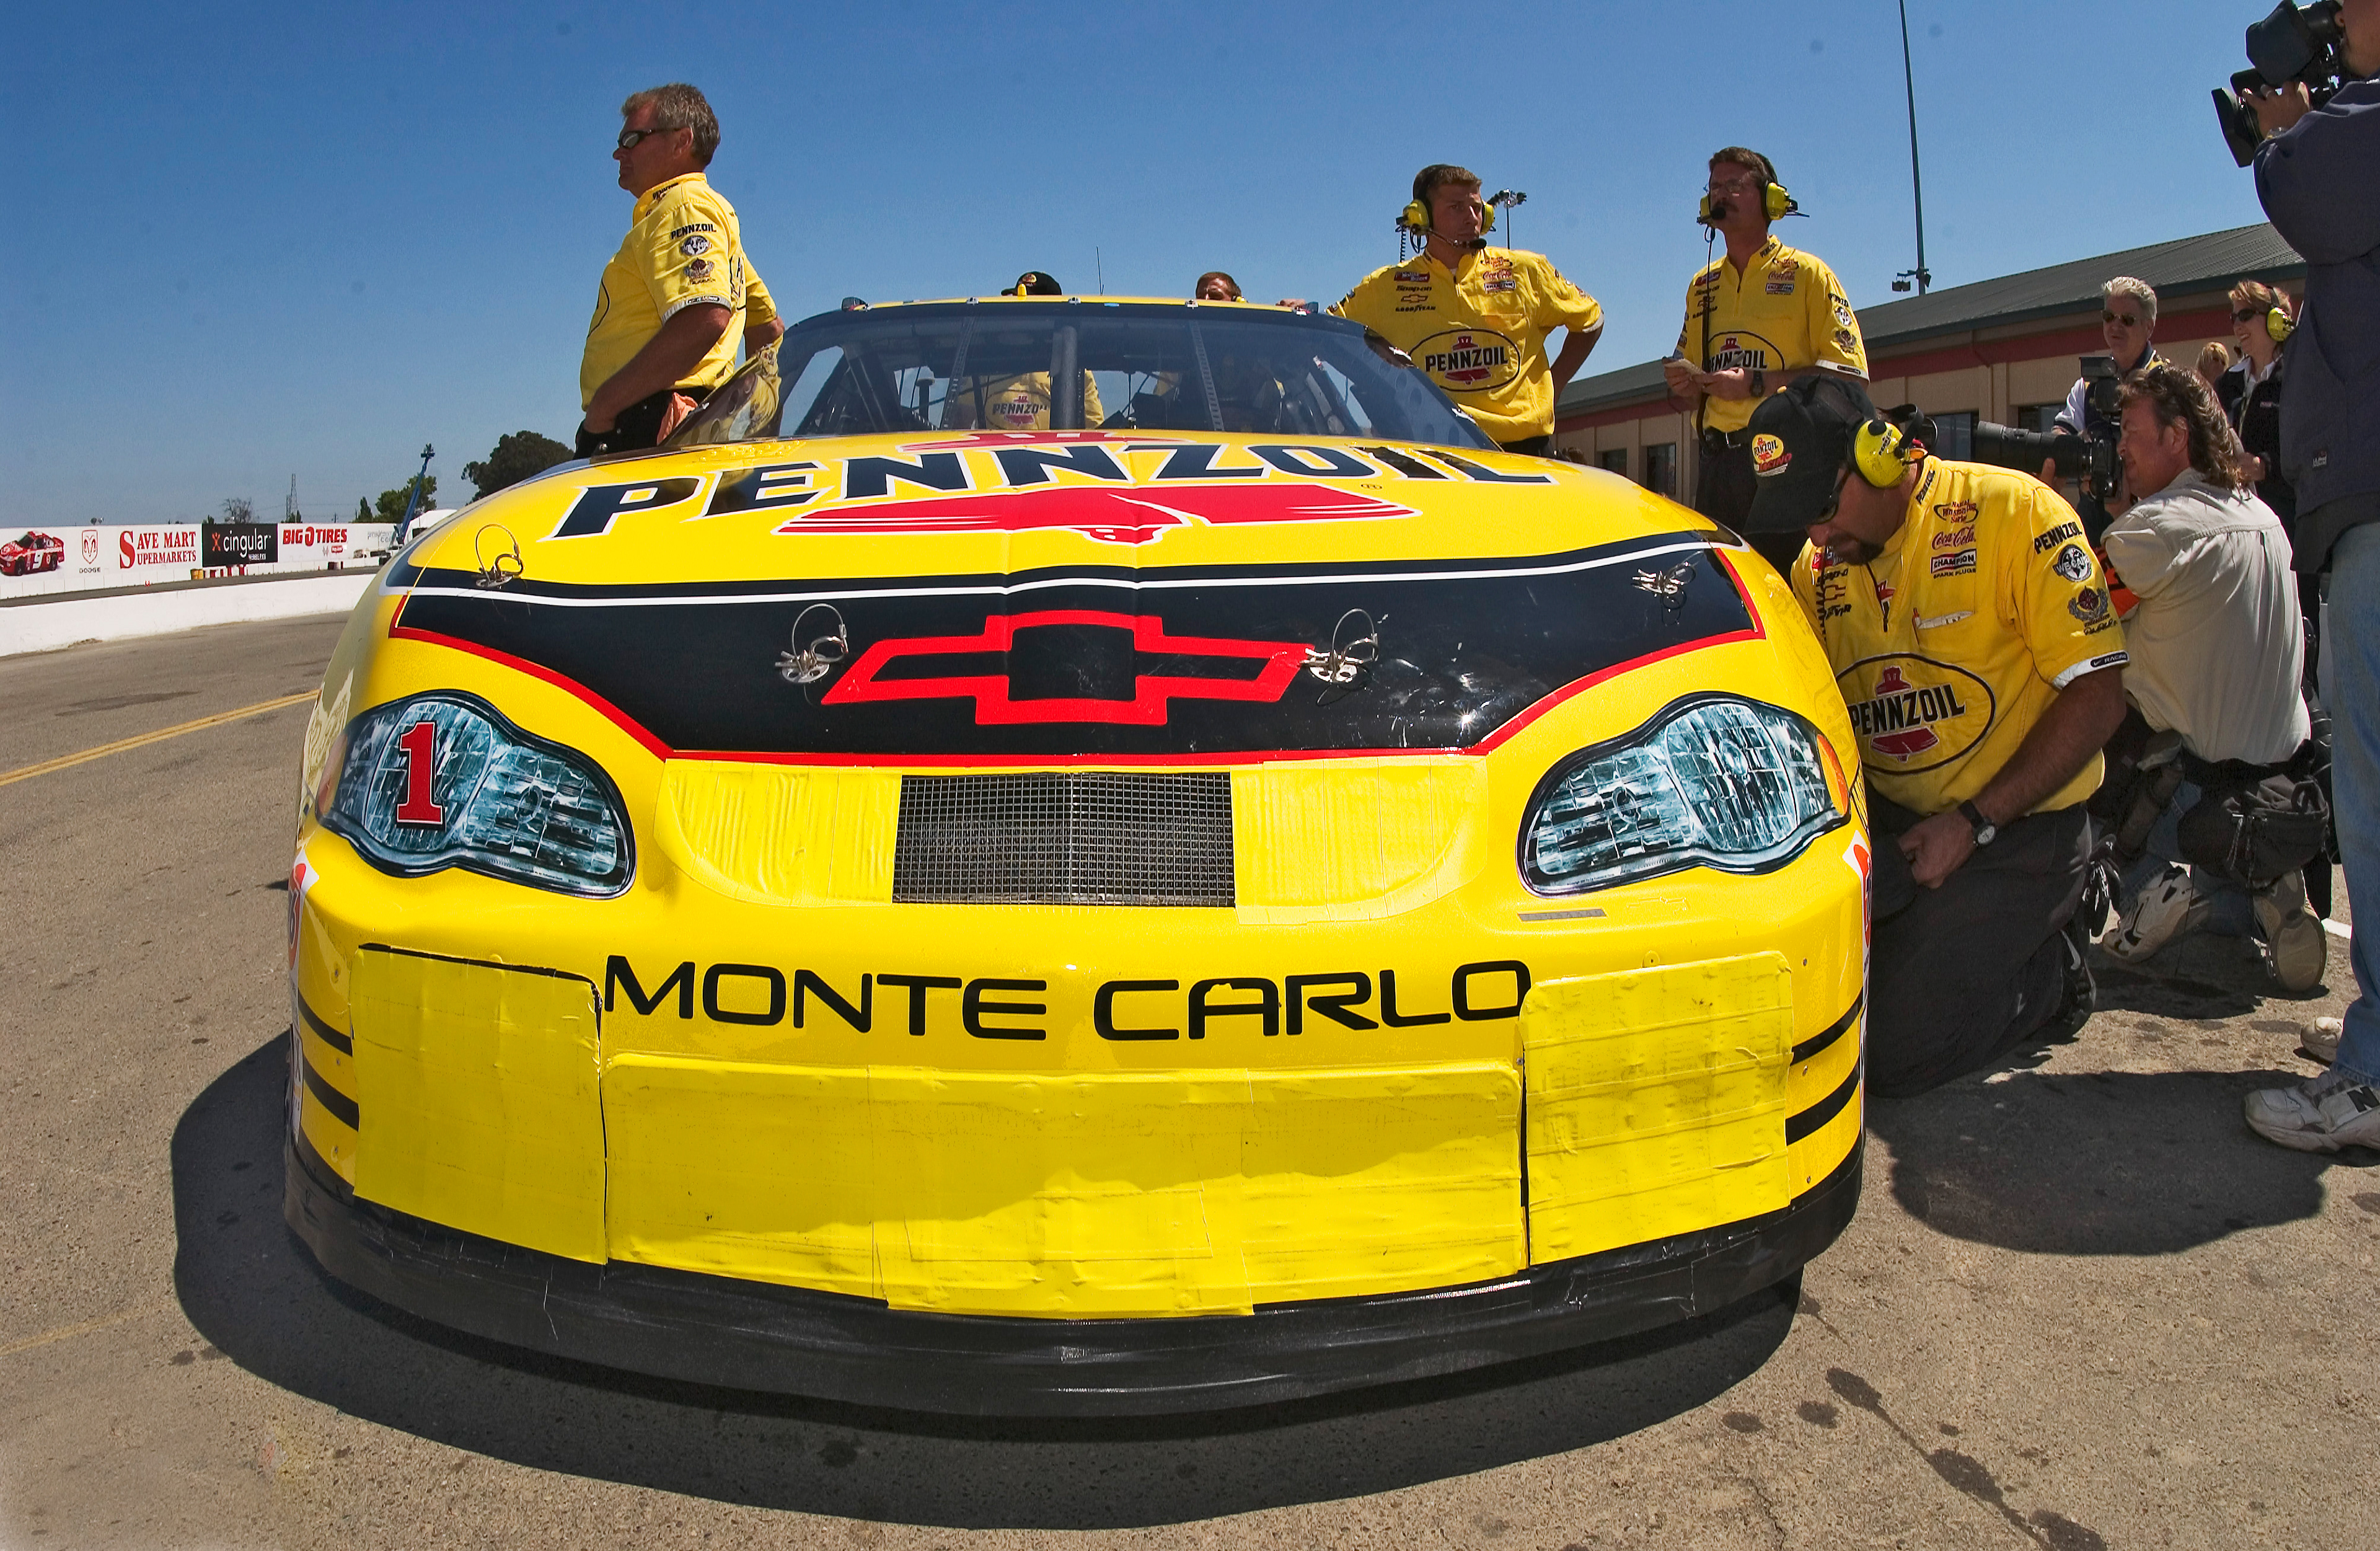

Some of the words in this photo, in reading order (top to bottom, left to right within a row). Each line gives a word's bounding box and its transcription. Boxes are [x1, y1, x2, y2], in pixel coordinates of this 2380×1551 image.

[671, 224, 716, 239] PENNZOIL
[1425, 345, 1509, 372] PENNZOIL
[539, 441, 1557, 541] PENNZOIL
[164, 531, 196, 548] MART
[223, 528, 268, 558] cingular
[283, 529, 303, 544] BIG
[315, 528, 348, 543] TIRES
[1931, 526, 1976, 550] Coca-Cola
[32, 552, 43, 569] 9
[1934, 554, 1975, 568] CHAMPION
[1848, 684, 1965, 735] PENNZOIL
[396, 721, 445, 829] 1
[604, 955, 1047, 1041] MONTE
[1094, 960, 1532, 1042] CARLO
